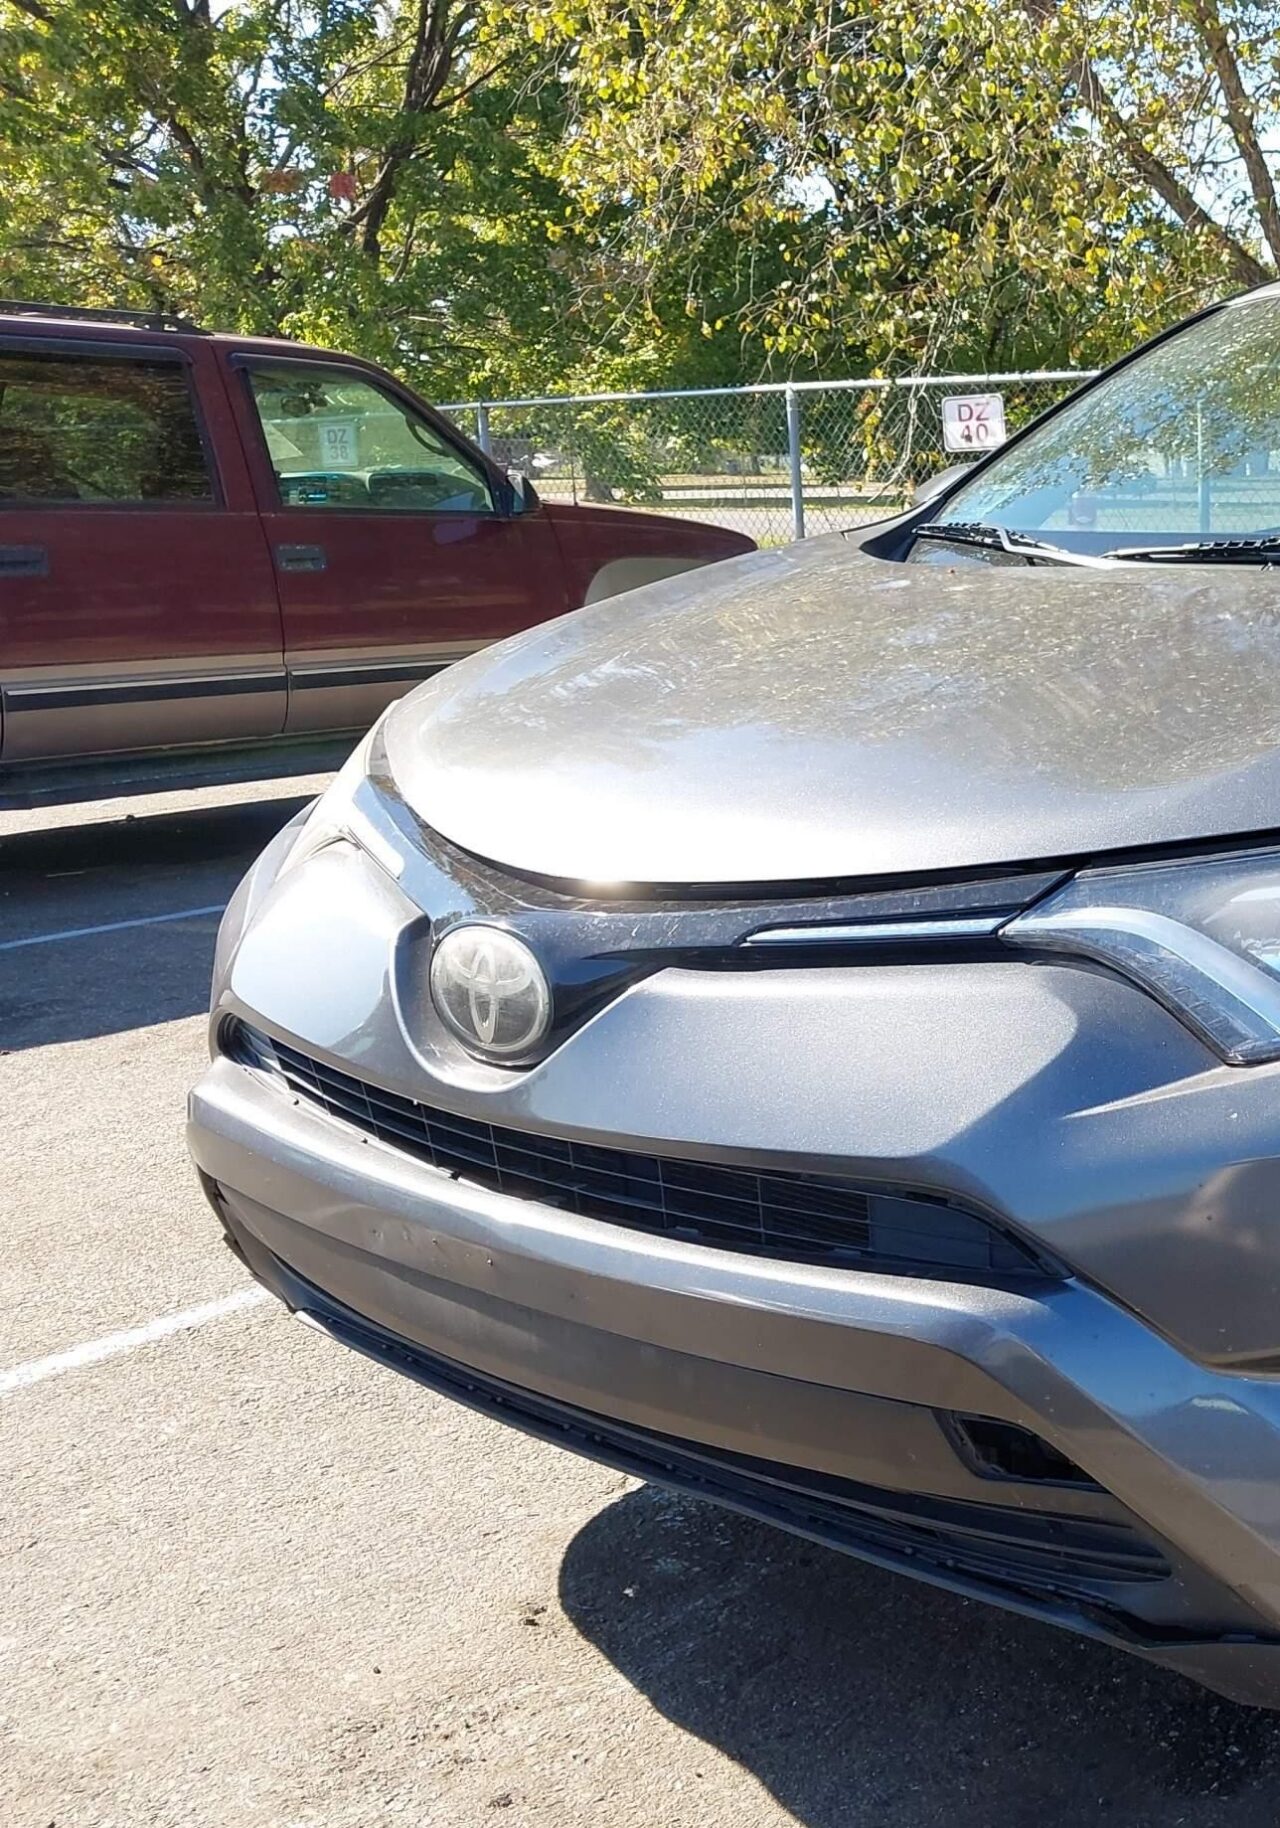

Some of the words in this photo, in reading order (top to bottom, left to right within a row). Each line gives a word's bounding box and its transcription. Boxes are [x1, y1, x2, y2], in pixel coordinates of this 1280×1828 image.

[957, 402, 990, 422] DZ
[326, 428, 348, 444] DZ
[960, 423, 989, 443] 40
